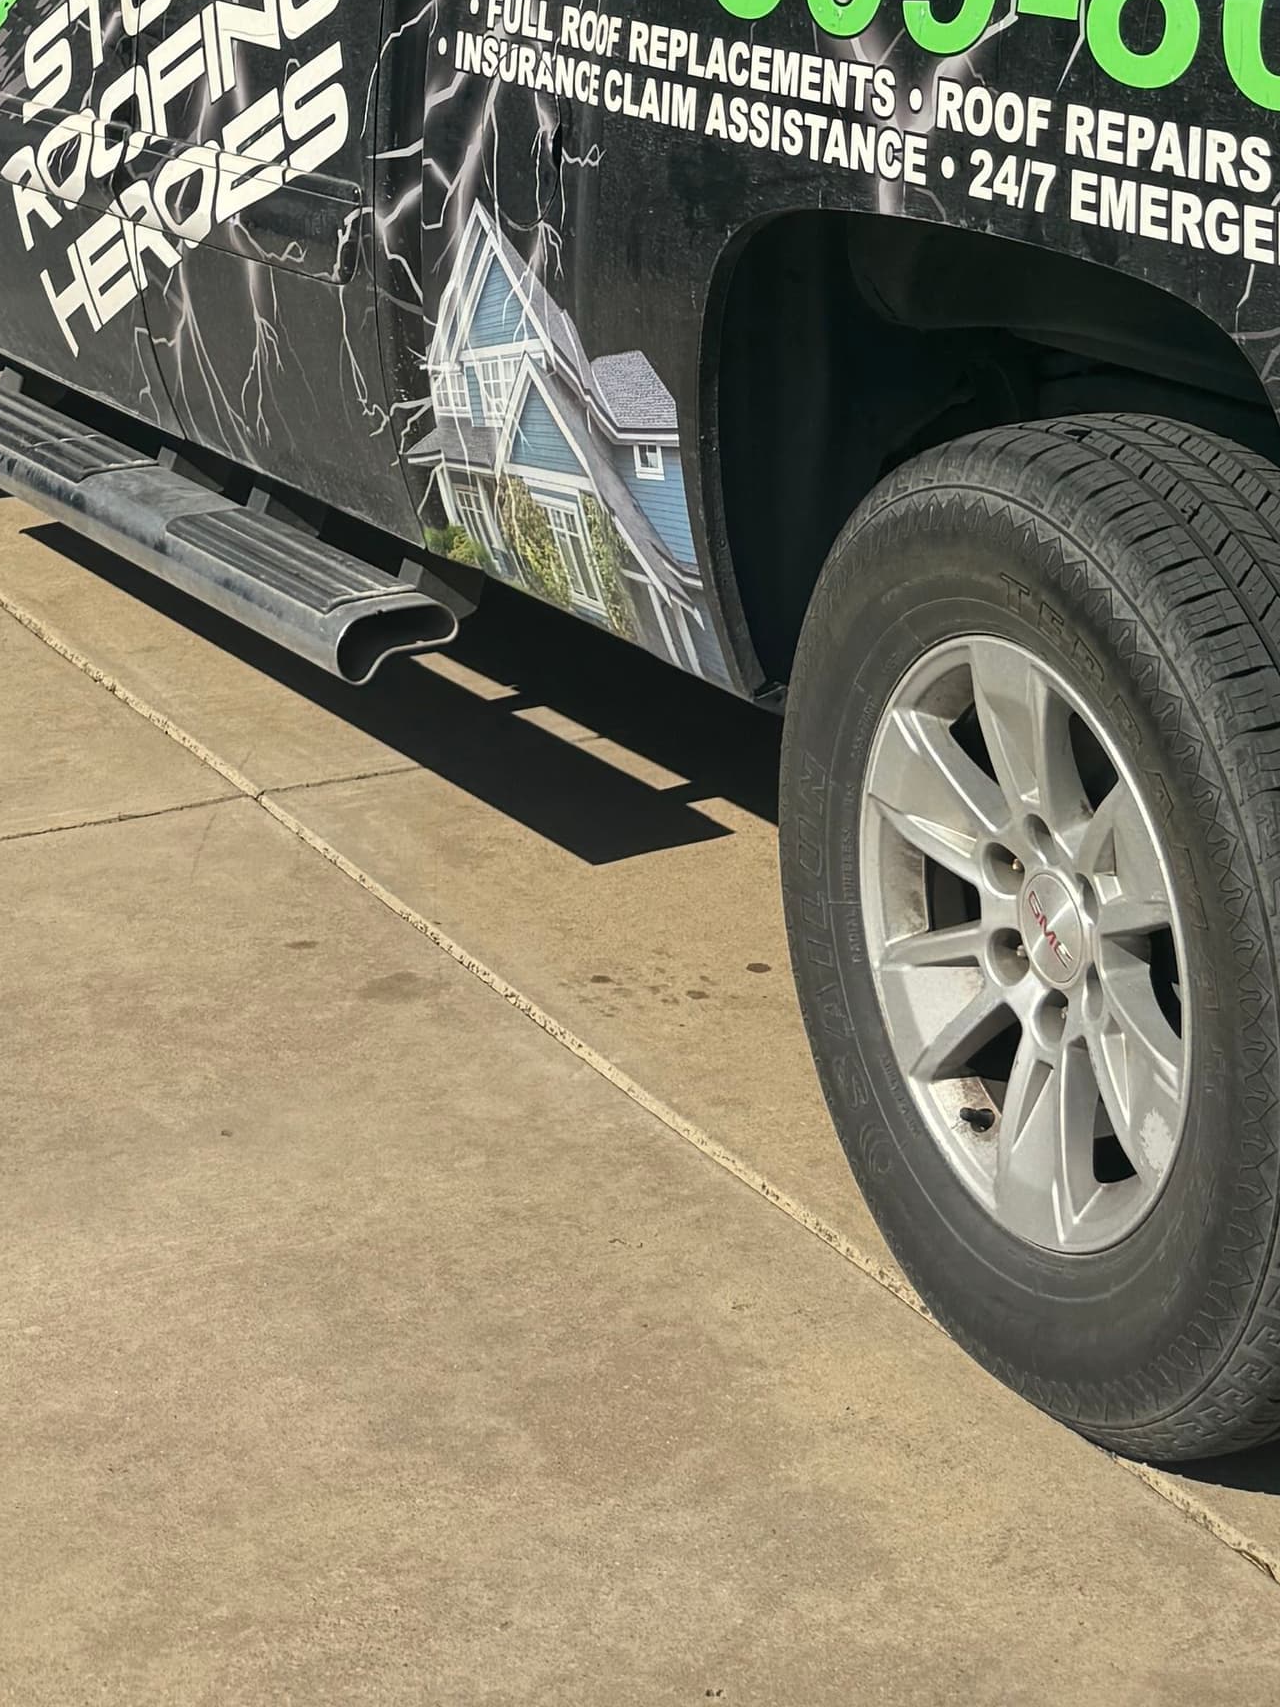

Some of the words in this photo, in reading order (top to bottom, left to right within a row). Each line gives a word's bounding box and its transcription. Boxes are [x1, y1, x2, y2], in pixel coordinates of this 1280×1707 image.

[454, 32, 600, 106] INSURANCE
[604, 68, 697, 132] CLAIM
[704, 93, 928, 185] ASSISTANCE
[969, 148, 1056, 214] 24/7
[561, 6, 622, 57] ROOF
[629, 23, 896, 118] REPLACEMENTS
[937, 82, 1051, 144] ROOF
[1065, 104, 1272, 191] REPAIRS
[40, 41, 349, 358] HEROES
[1028, 890, 1074, 970] GMC
